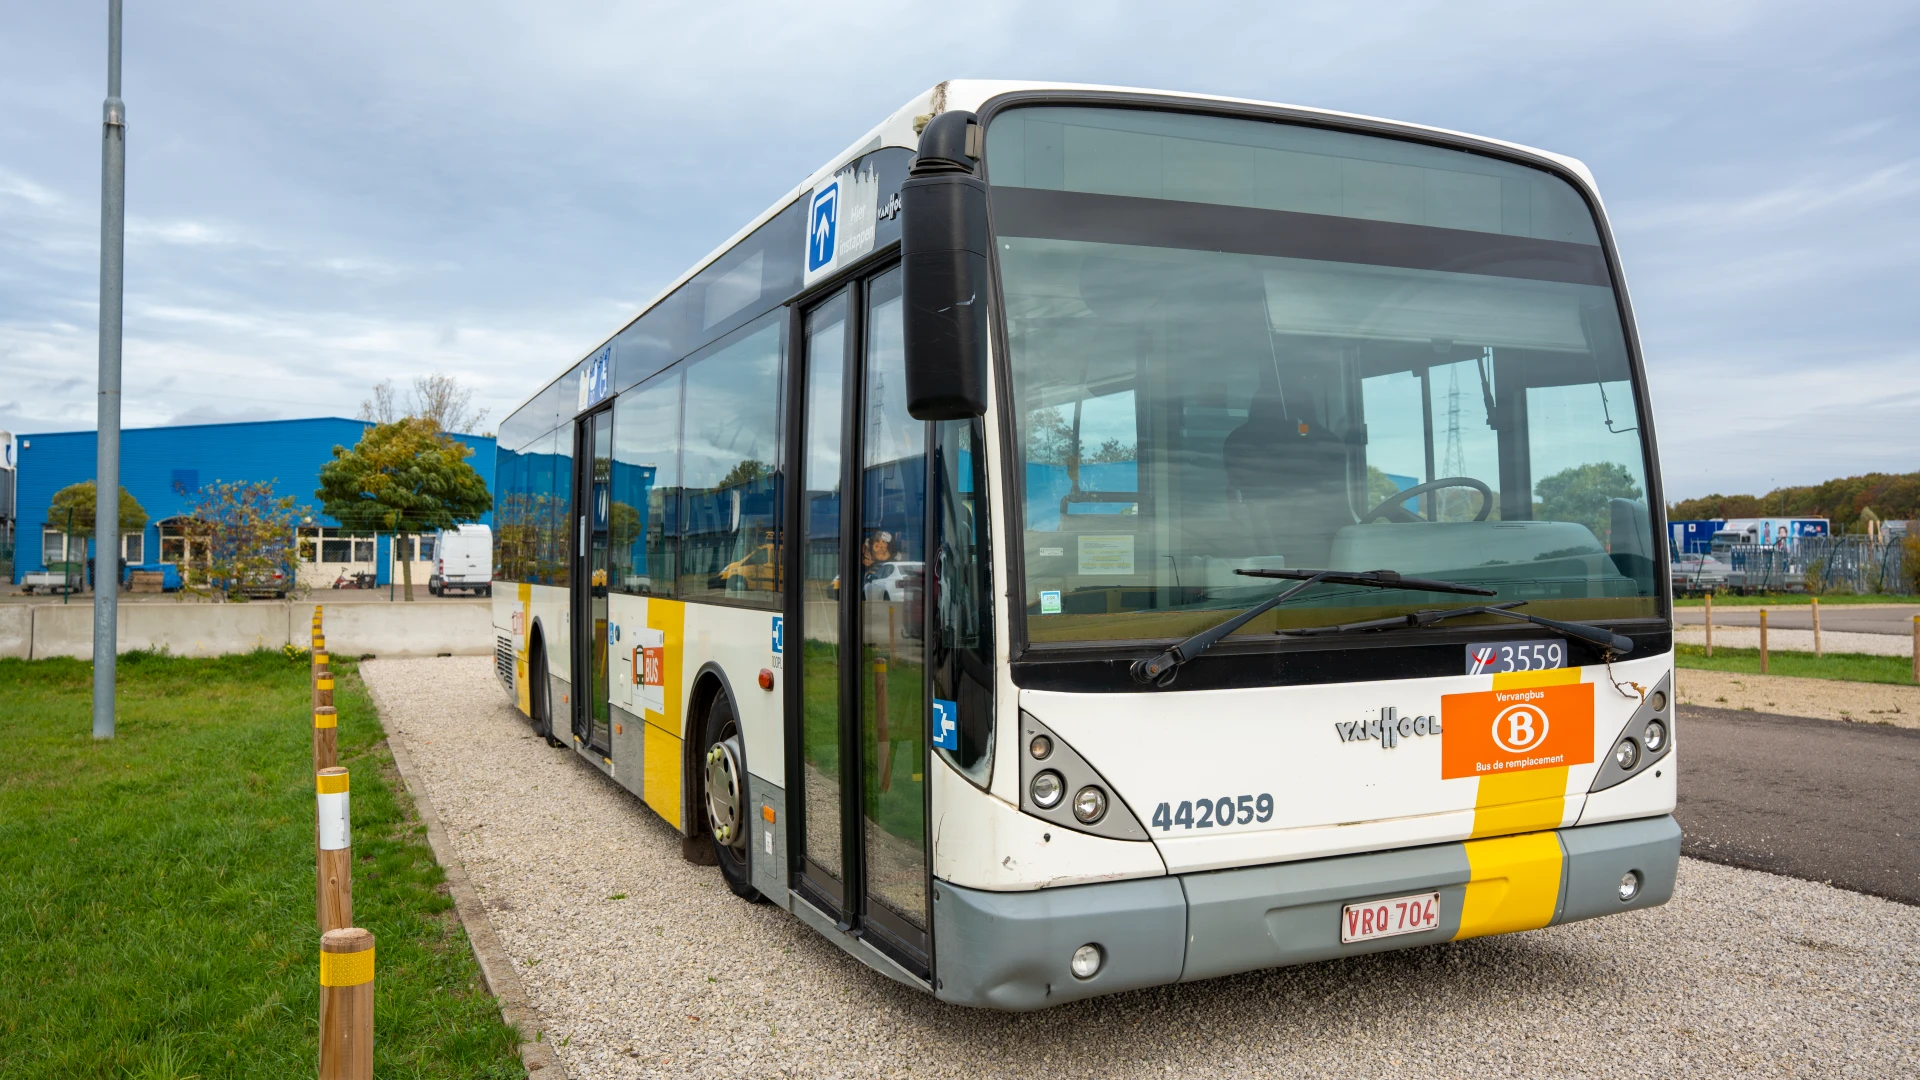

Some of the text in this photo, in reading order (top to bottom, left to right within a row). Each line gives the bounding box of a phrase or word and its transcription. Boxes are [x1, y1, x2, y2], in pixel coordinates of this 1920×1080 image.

[839, 225, 874, 256] instappen
[645, 657, 659, 683] BUS
[1500, 643, 1562, 674] 3559
[1495, 690, 1545, 702] Vervangbus
[1507, 711, 1535, 746] B
[1476, 753, 1564, 772] Bus de remplacement
[1151, 792, 1274, 831] 442059
[1348, 899, 1435, 937] VRQ 704
